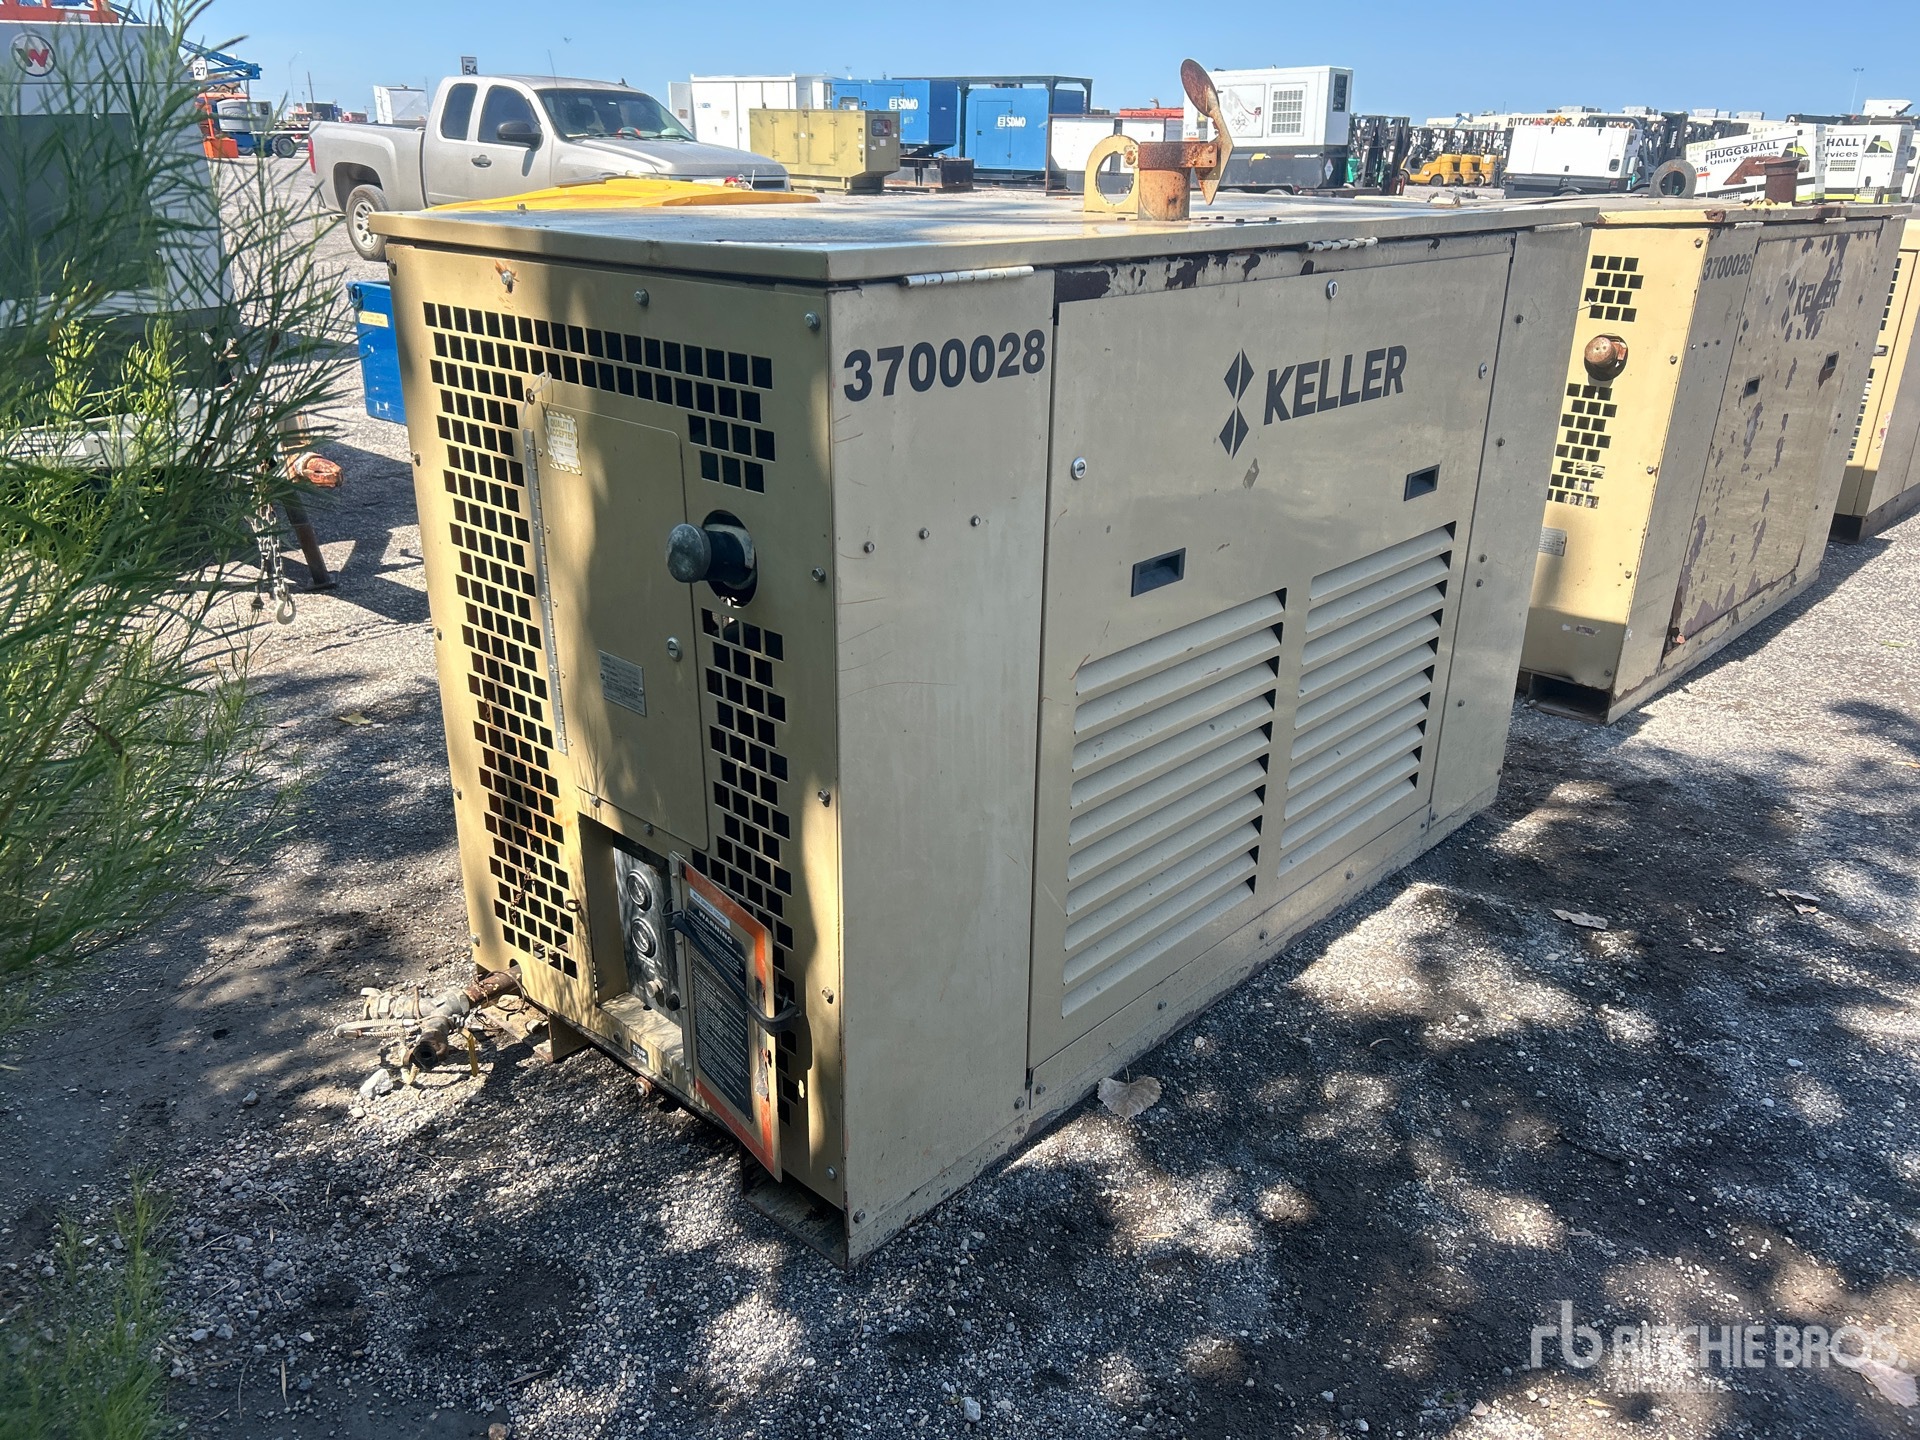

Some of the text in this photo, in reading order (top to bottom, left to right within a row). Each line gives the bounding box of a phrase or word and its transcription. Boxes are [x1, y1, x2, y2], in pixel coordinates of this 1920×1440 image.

[194, 66, 206, 76] 27
[464, 65, 478, 76] 54
[898, 98, 919, 110] SDMO
[1006, 116, 1027, 128] SDMO
[1826, 138, 1860, 147] HALL
[1703, 253, 1753, 281] 3700026
[843, 328, 1046, 403] 3700028
[1263, 344, 1408, 426] KELLER
[698, 909, 734, 945] WARNING
